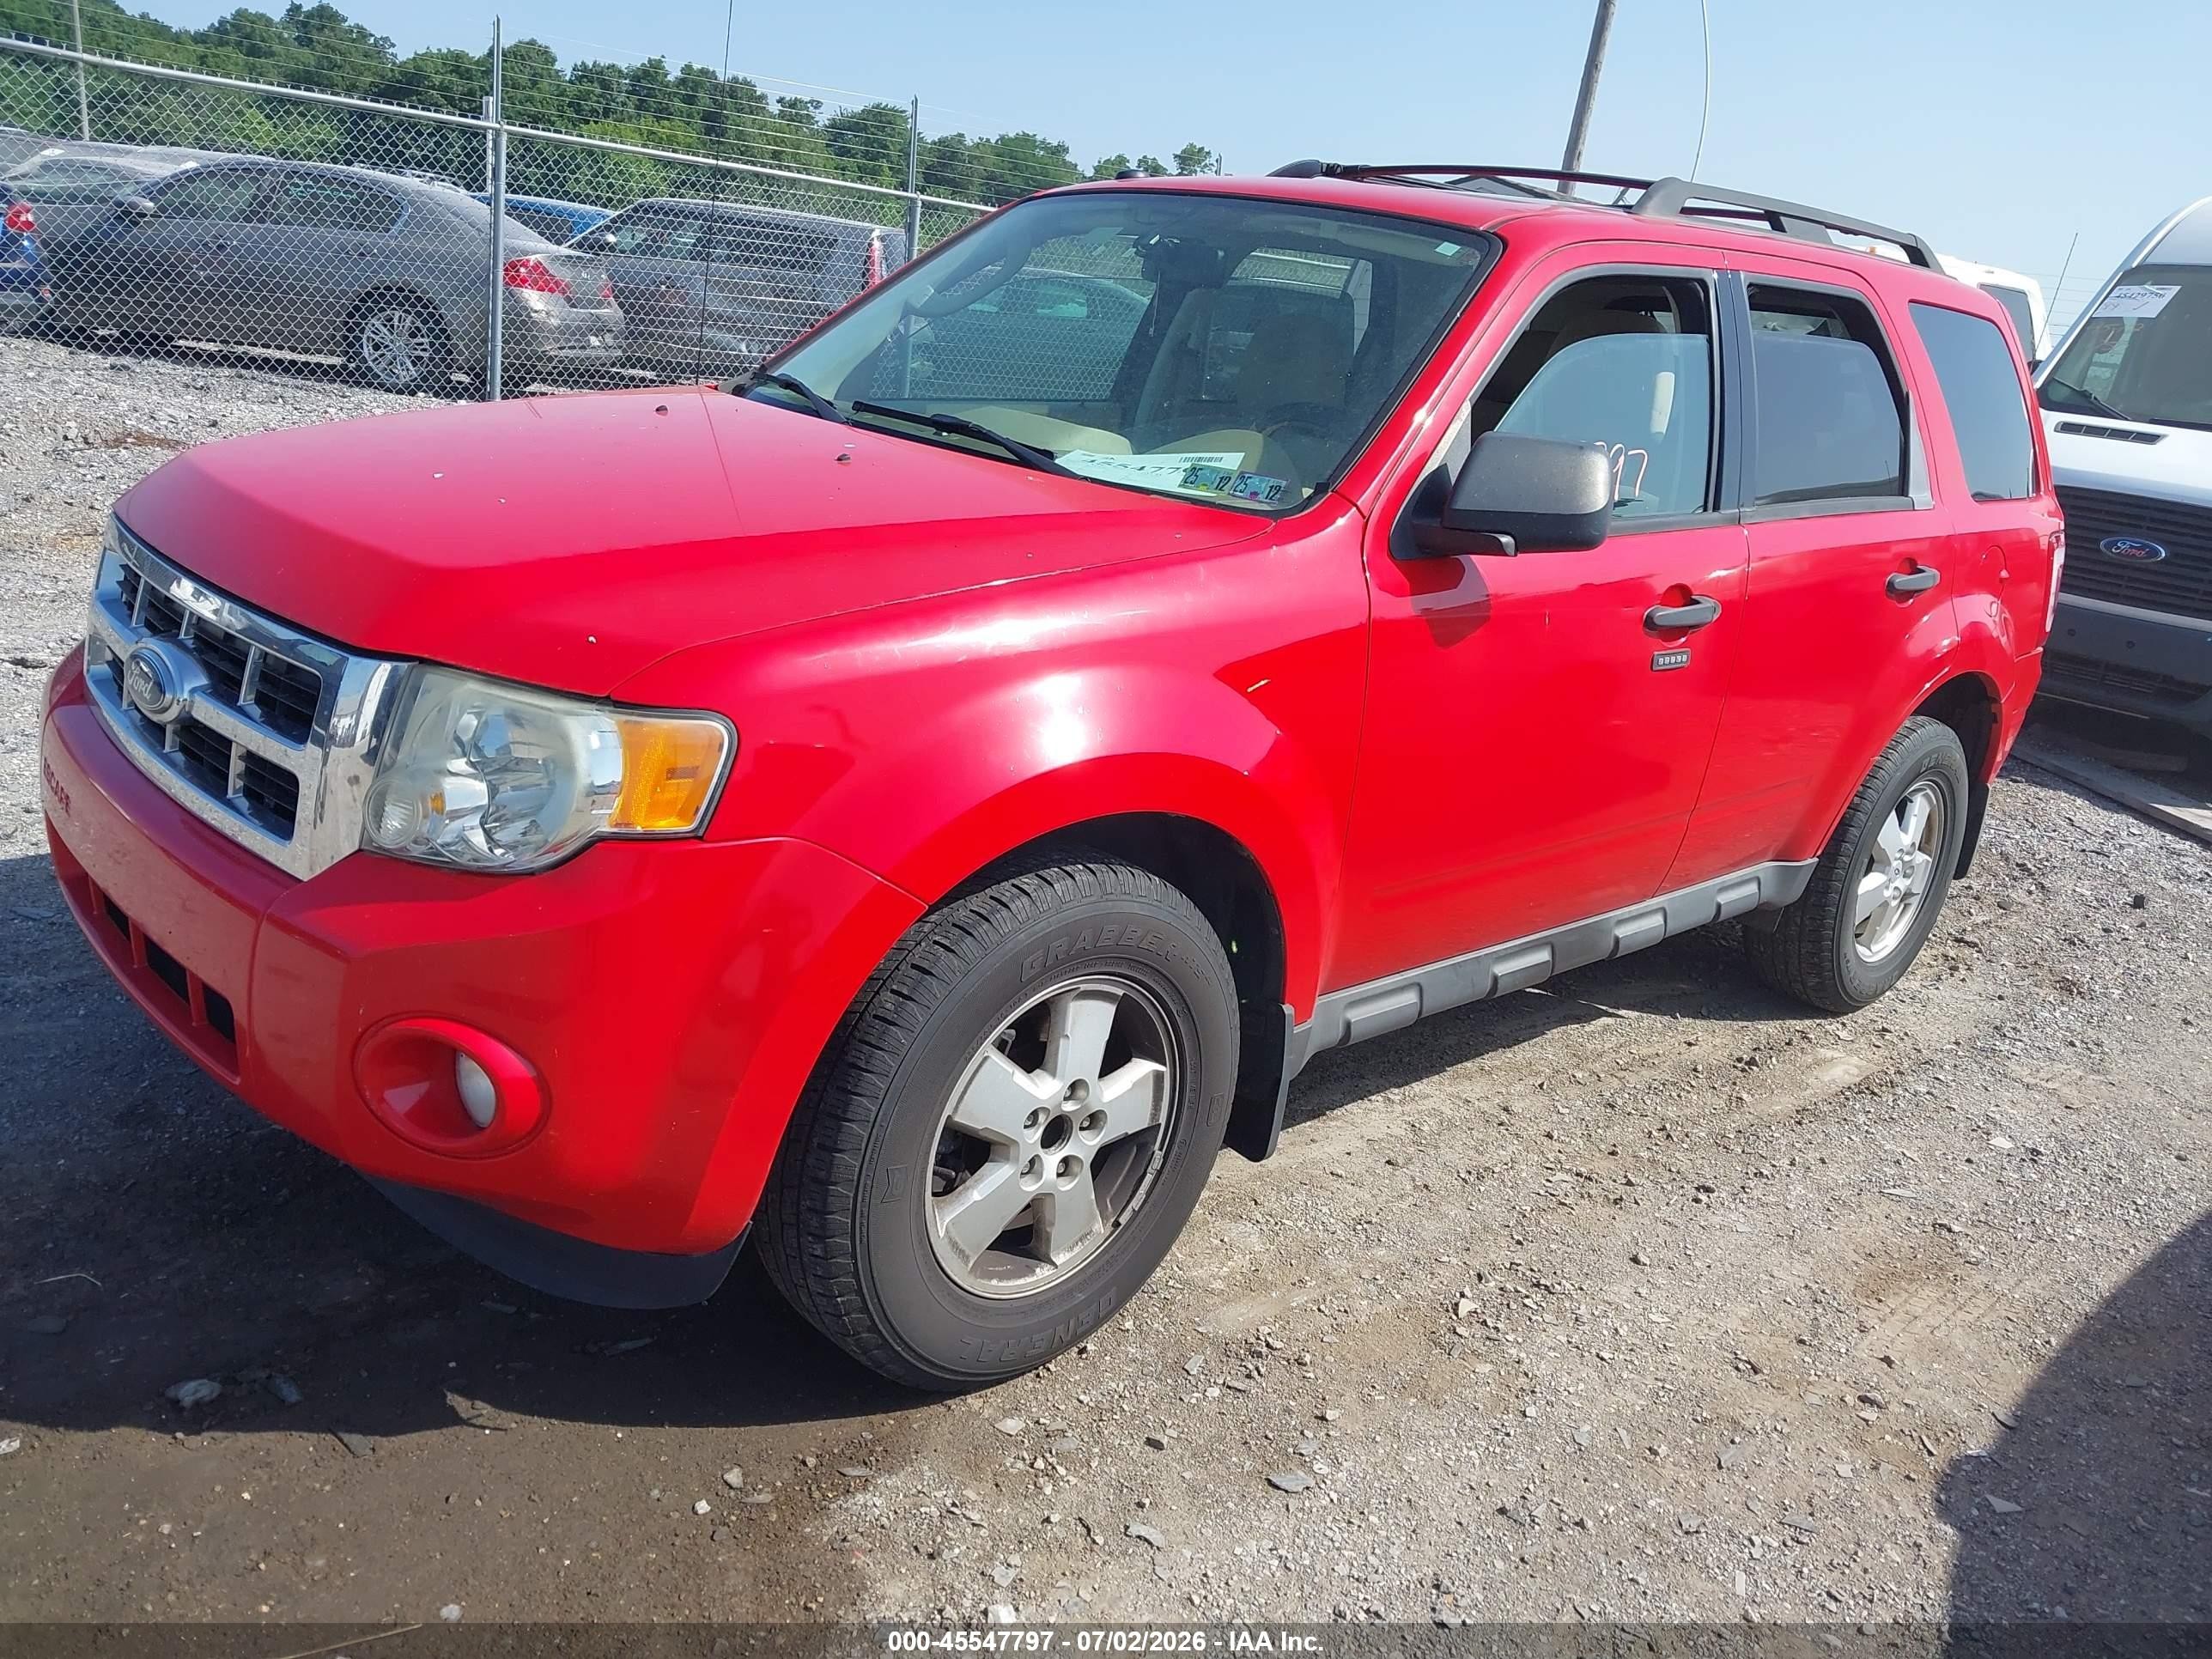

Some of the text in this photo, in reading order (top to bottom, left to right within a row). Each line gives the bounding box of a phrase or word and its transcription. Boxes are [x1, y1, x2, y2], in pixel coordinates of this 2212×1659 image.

[1184, 467, 1231, 491] 25 12
[1233, 476, 1282, 501] 25 12
[2112, 540, 2150, 557] Ford
[127, 658, 154, 700] Ford
[1020, 924, 1177, 982] GRABBER
